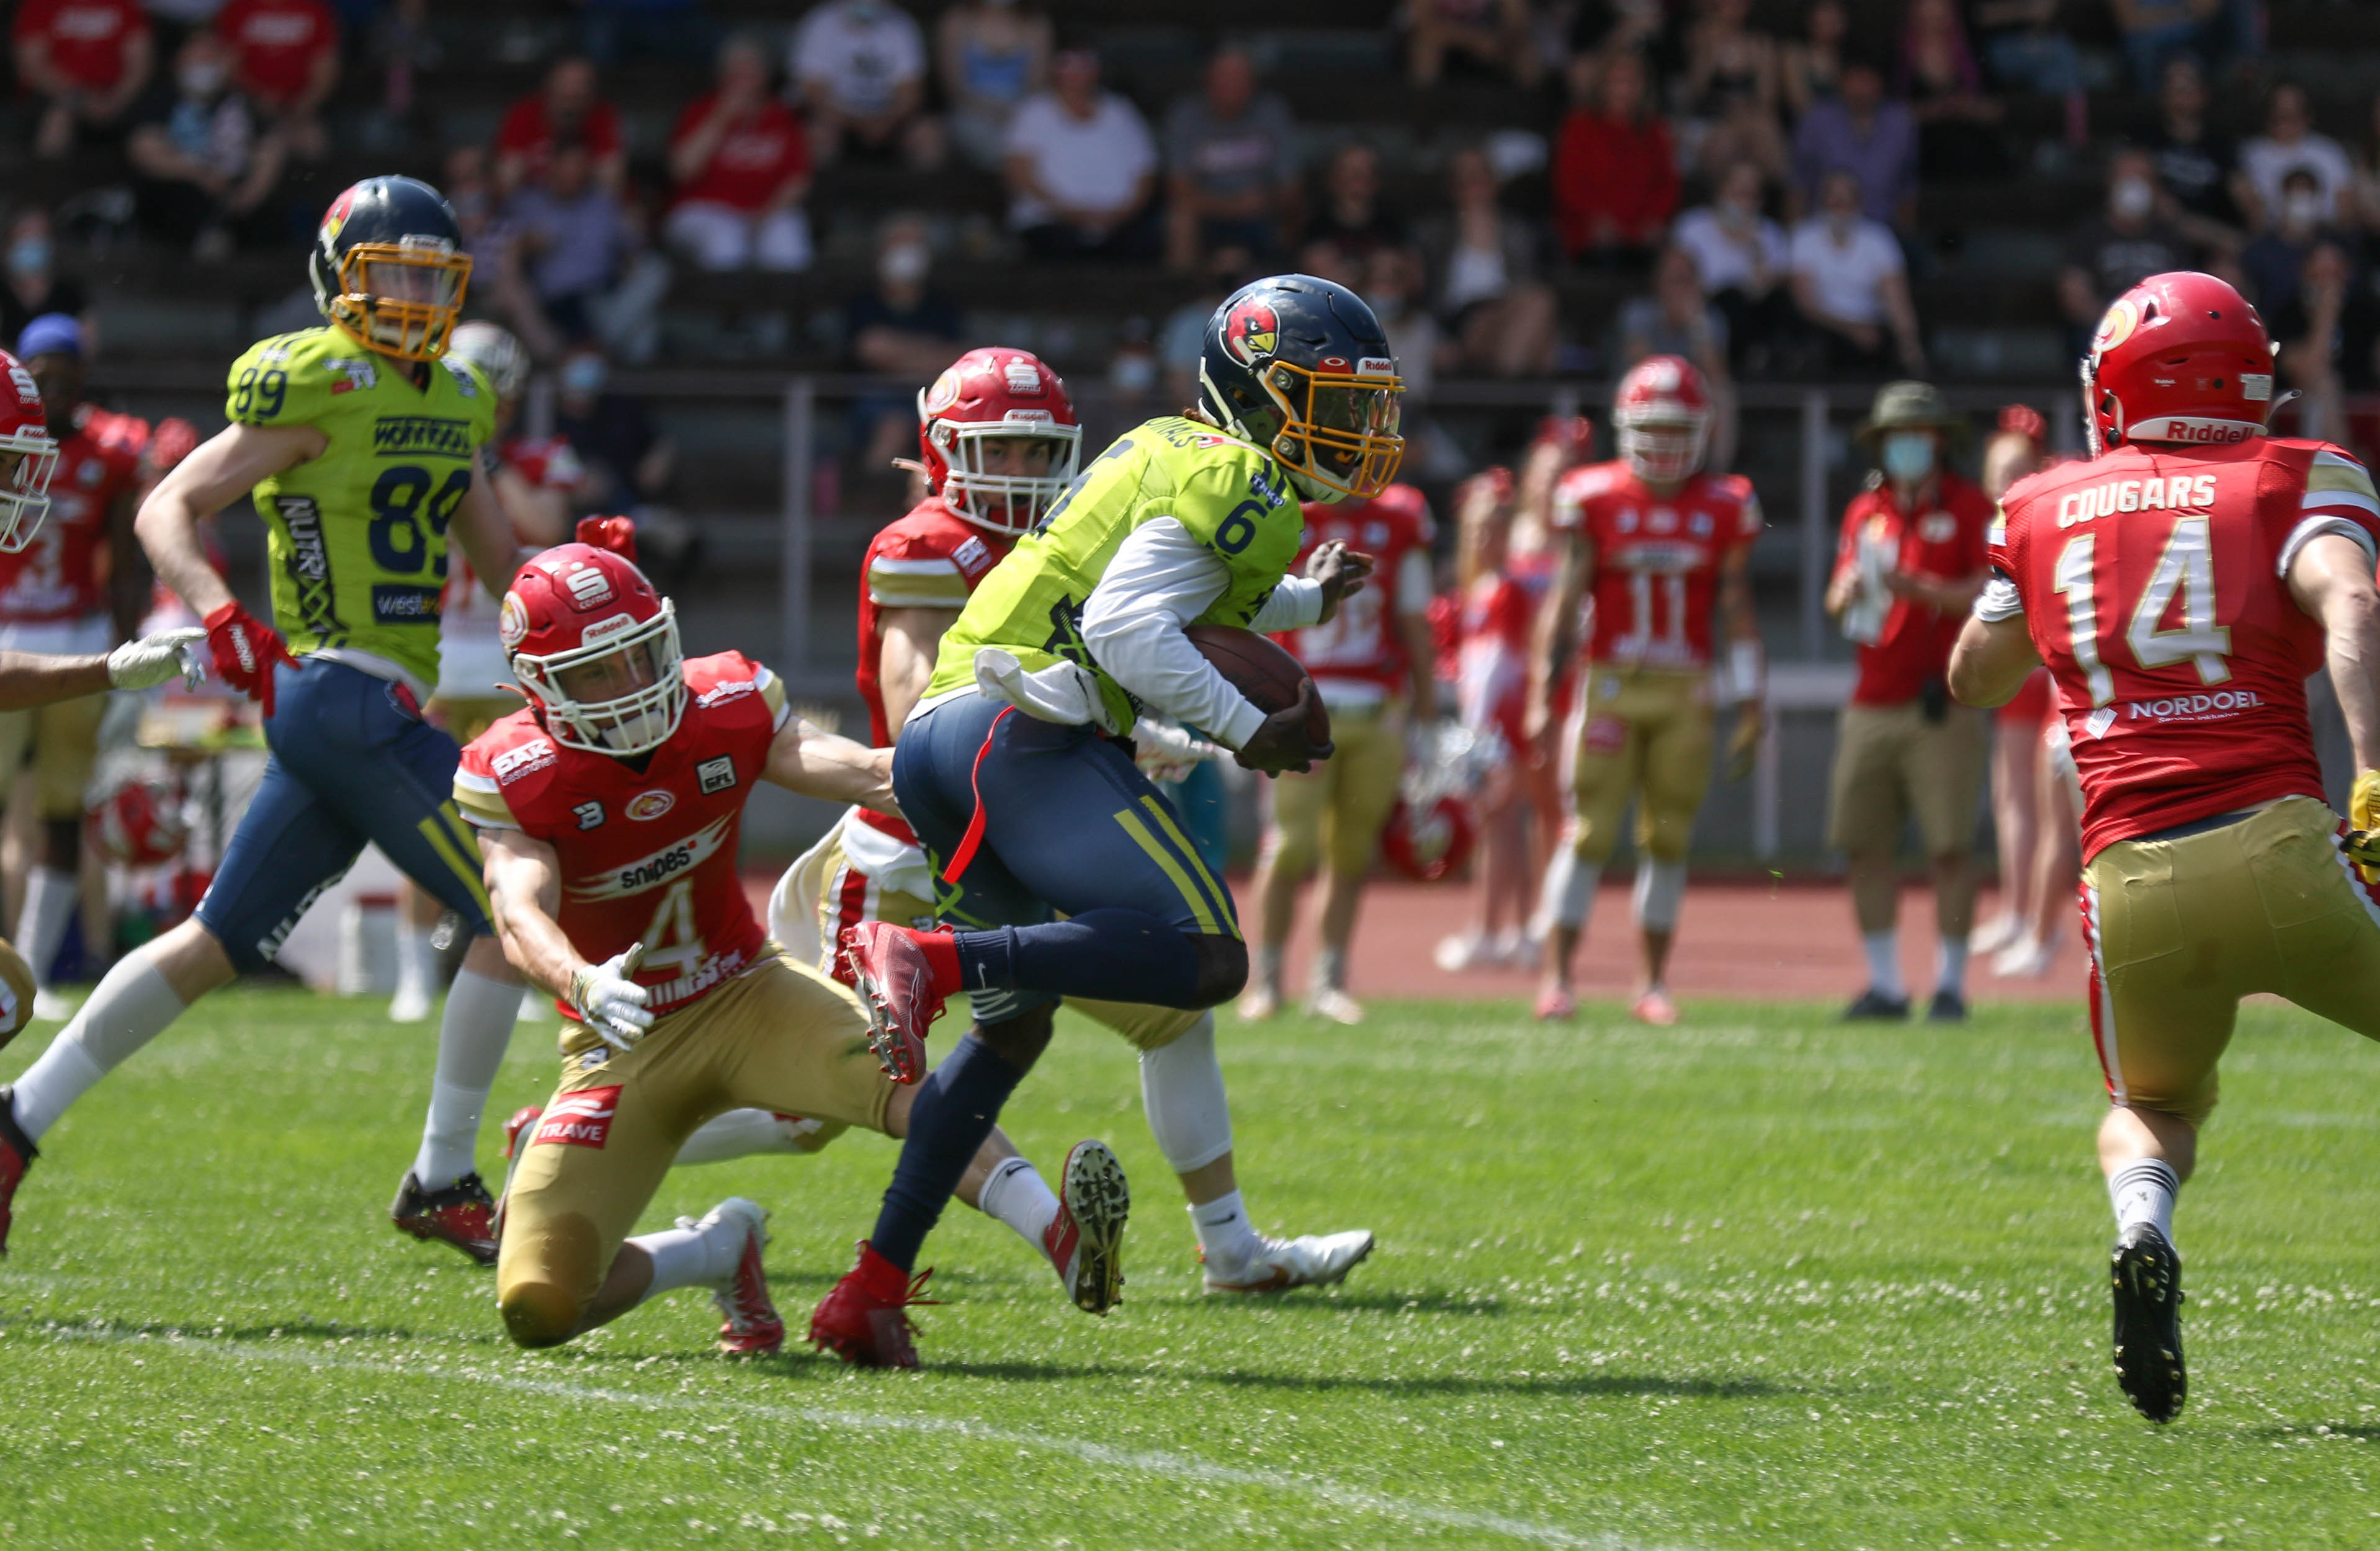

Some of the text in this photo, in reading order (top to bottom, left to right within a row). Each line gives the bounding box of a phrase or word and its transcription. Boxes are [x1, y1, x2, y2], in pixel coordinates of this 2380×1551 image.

[236, 368, 287, 416] 89
[2167, 420, 2255, 444] Riddell
[369, 465, 471, 578] 89
[2059, 475, 2216, 529] COUGARS
[1215, 499, 1268, 555] 6
[2054, 515, 2233, 710] 14
[2130, 691, 2265, 720] NORDOEL
[705, 772, 733, 789] GFL
[621, 845, 691, 889] snipes
[641, 876, 709, 978] 4
[539, 1122, 603, 1142] TRAVE
